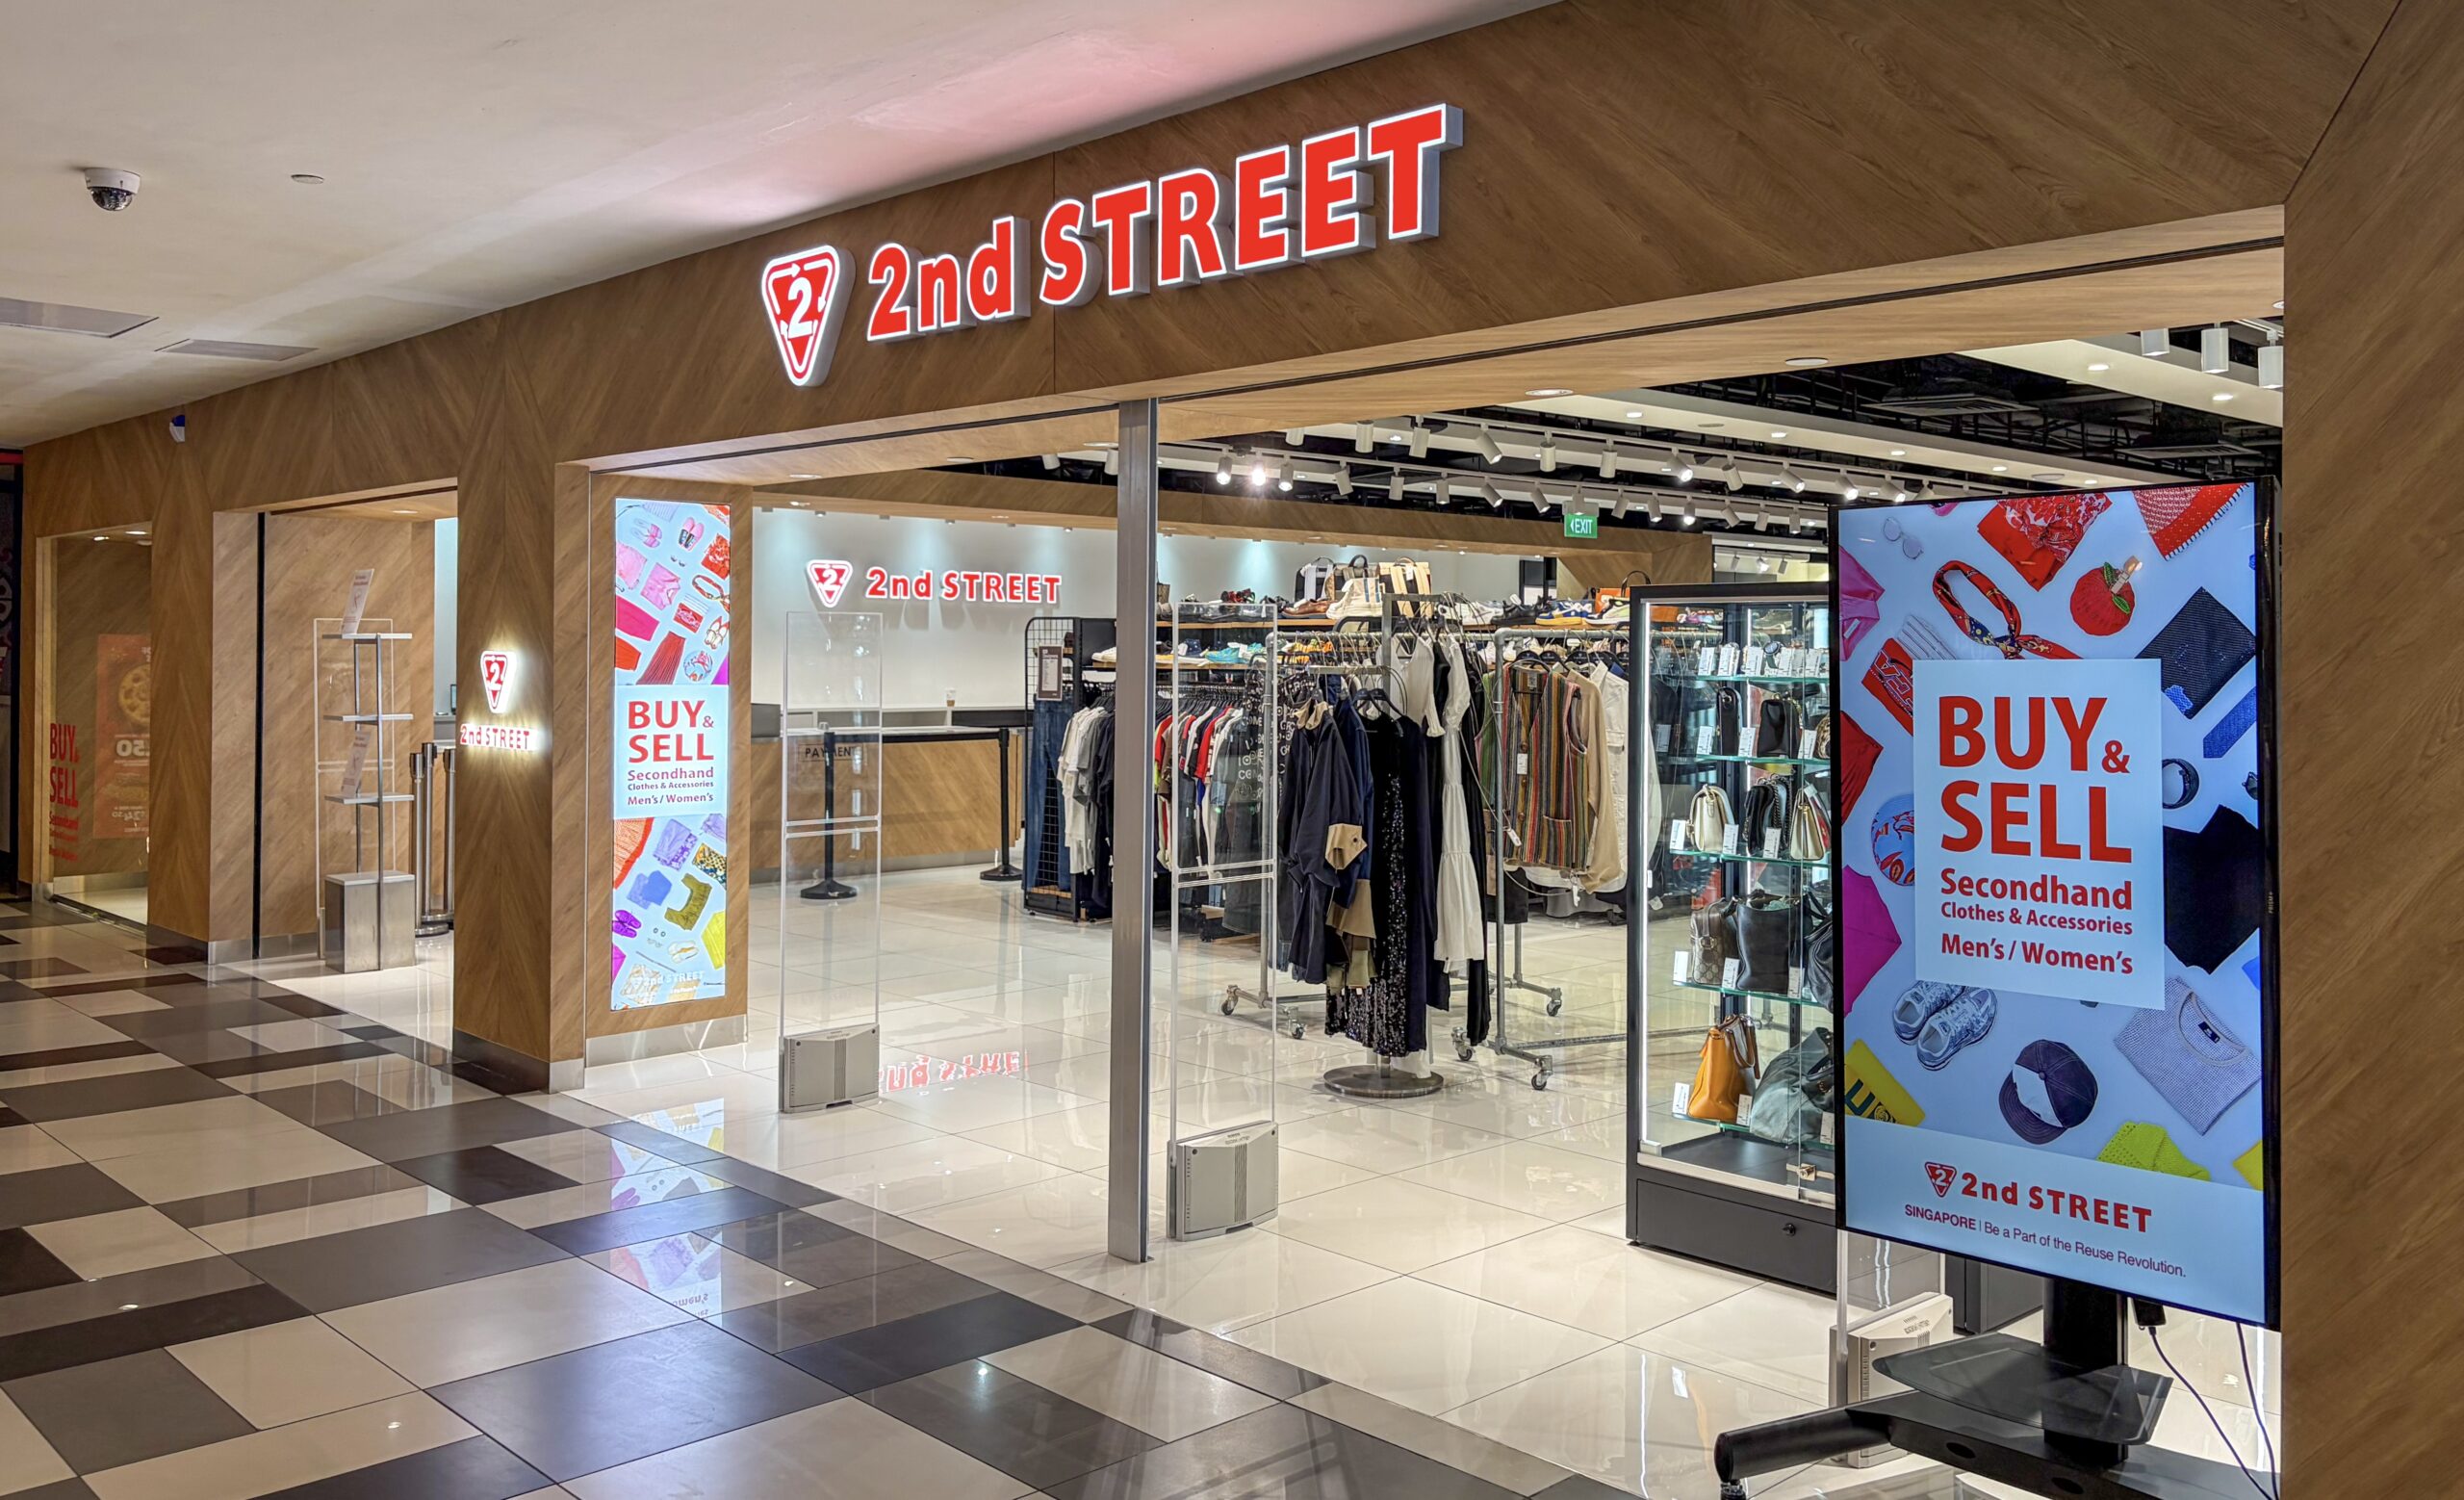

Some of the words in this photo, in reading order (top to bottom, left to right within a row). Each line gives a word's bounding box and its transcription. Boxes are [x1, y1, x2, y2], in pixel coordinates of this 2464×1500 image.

[868, 216, 1015, 342] 2nd
[1039, 102, 1448, 307] STREET
[1575, 518, 1593, 534] EXIT
[866, 566, 933, 600] 2nd
[941, 570, 1062, 605] STREET
[628, 700, 706, 730] BUY
[702, 715, 714, 729] &
[1938, 695, 2108, 772] BUY
[2101, 739, 2131, 774] &
[460, 724, 482, 745] 2nd
[486, 727, 530, 750] STREET
[628, 733, 715, 763] SELL
[49, 765, 78, 809] SELL
[628, 766, 714, 782] Secondhand
[628, 782, 658, 790] Clothes
[668, 781, 714, 789] Accessories
[1940, 779, 2132, 864] SELL
[1940, 867, 2133, 911] Secondhand
[1940, 901, 2005, 923] Clothes
[2009, 907, 2022, 924] &
[2026, 909, 2133, 936] Accessories
[1961, 1172, 2018, 1206] 2nd
[2028, 1185, 2152, 1233] STREET
[1904, 1203, 1977, 1231] SINGAPORE
[1984, 1221, 2000, 1236] Be
[2002, 1229, 2011, 1238] a
[2013, 1228, 2037, 1245] Part
[2039, 1234, 2051, 1247] of
[2053, 1237, 2072, 1253] the
[2075, 1241, 2115, 1261] Reuse
[2118, 1251, 2187, 1279] Revolution.
